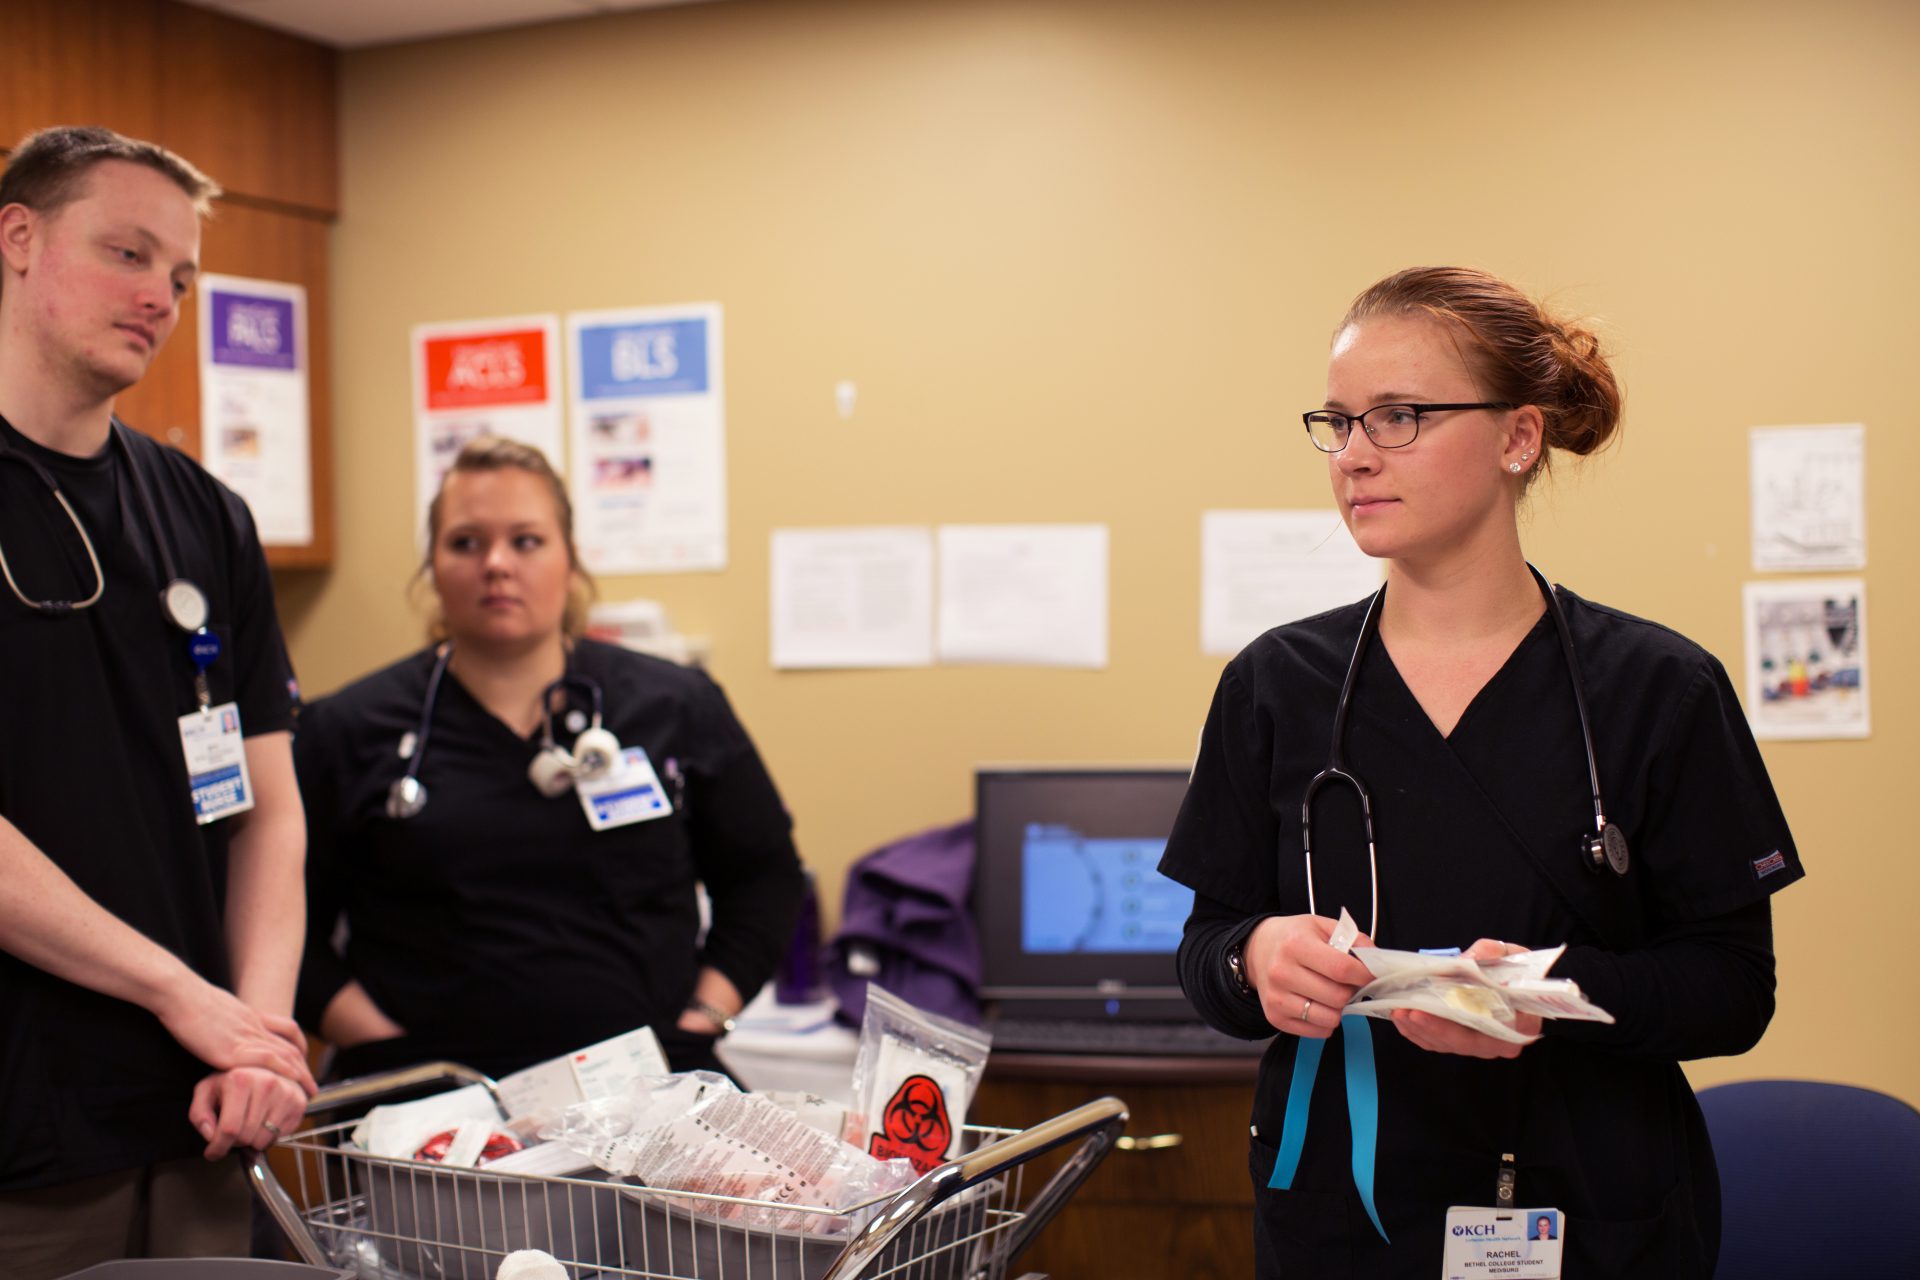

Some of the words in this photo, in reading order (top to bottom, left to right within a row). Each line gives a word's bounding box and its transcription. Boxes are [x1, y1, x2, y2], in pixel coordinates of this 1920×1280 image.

[611, 332, 679, 382] BLS
[1465, 1224, 1495, 1236] KCH
[1486, 1250, 1521, 1259] RACHEL
